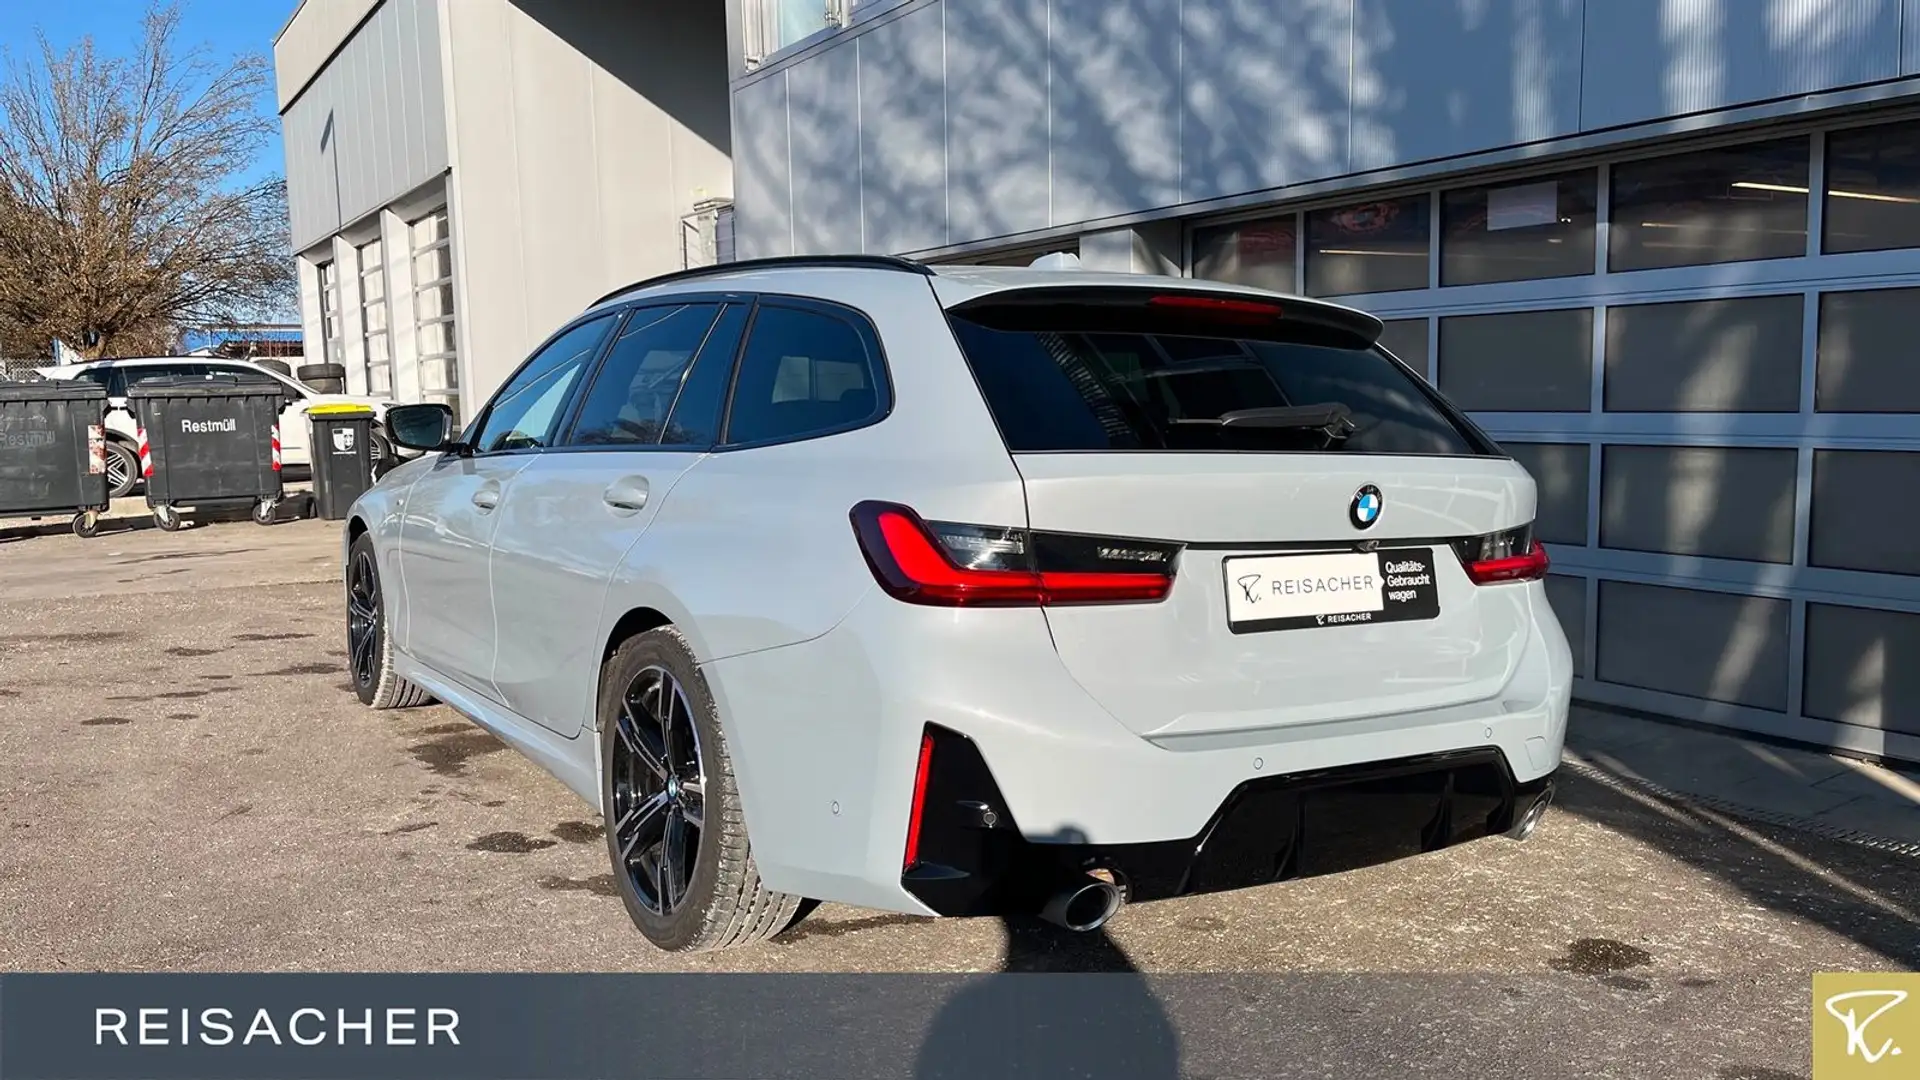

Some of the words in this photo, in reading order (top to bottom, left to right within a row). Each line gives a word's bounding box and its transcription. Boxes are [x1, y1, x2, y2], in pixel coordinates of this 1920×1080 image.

[181, 419, 236, 432] Restmüll
[1385, 561, 1425, 574] Qualitäts-
[1271, 575, 1374, 595] REISACHER
[1387, 575, 1430, 588] Gebraucht
[1388, 590, 1417, 603] wagen
[1327, 613, 1372, 623] REISACHER
